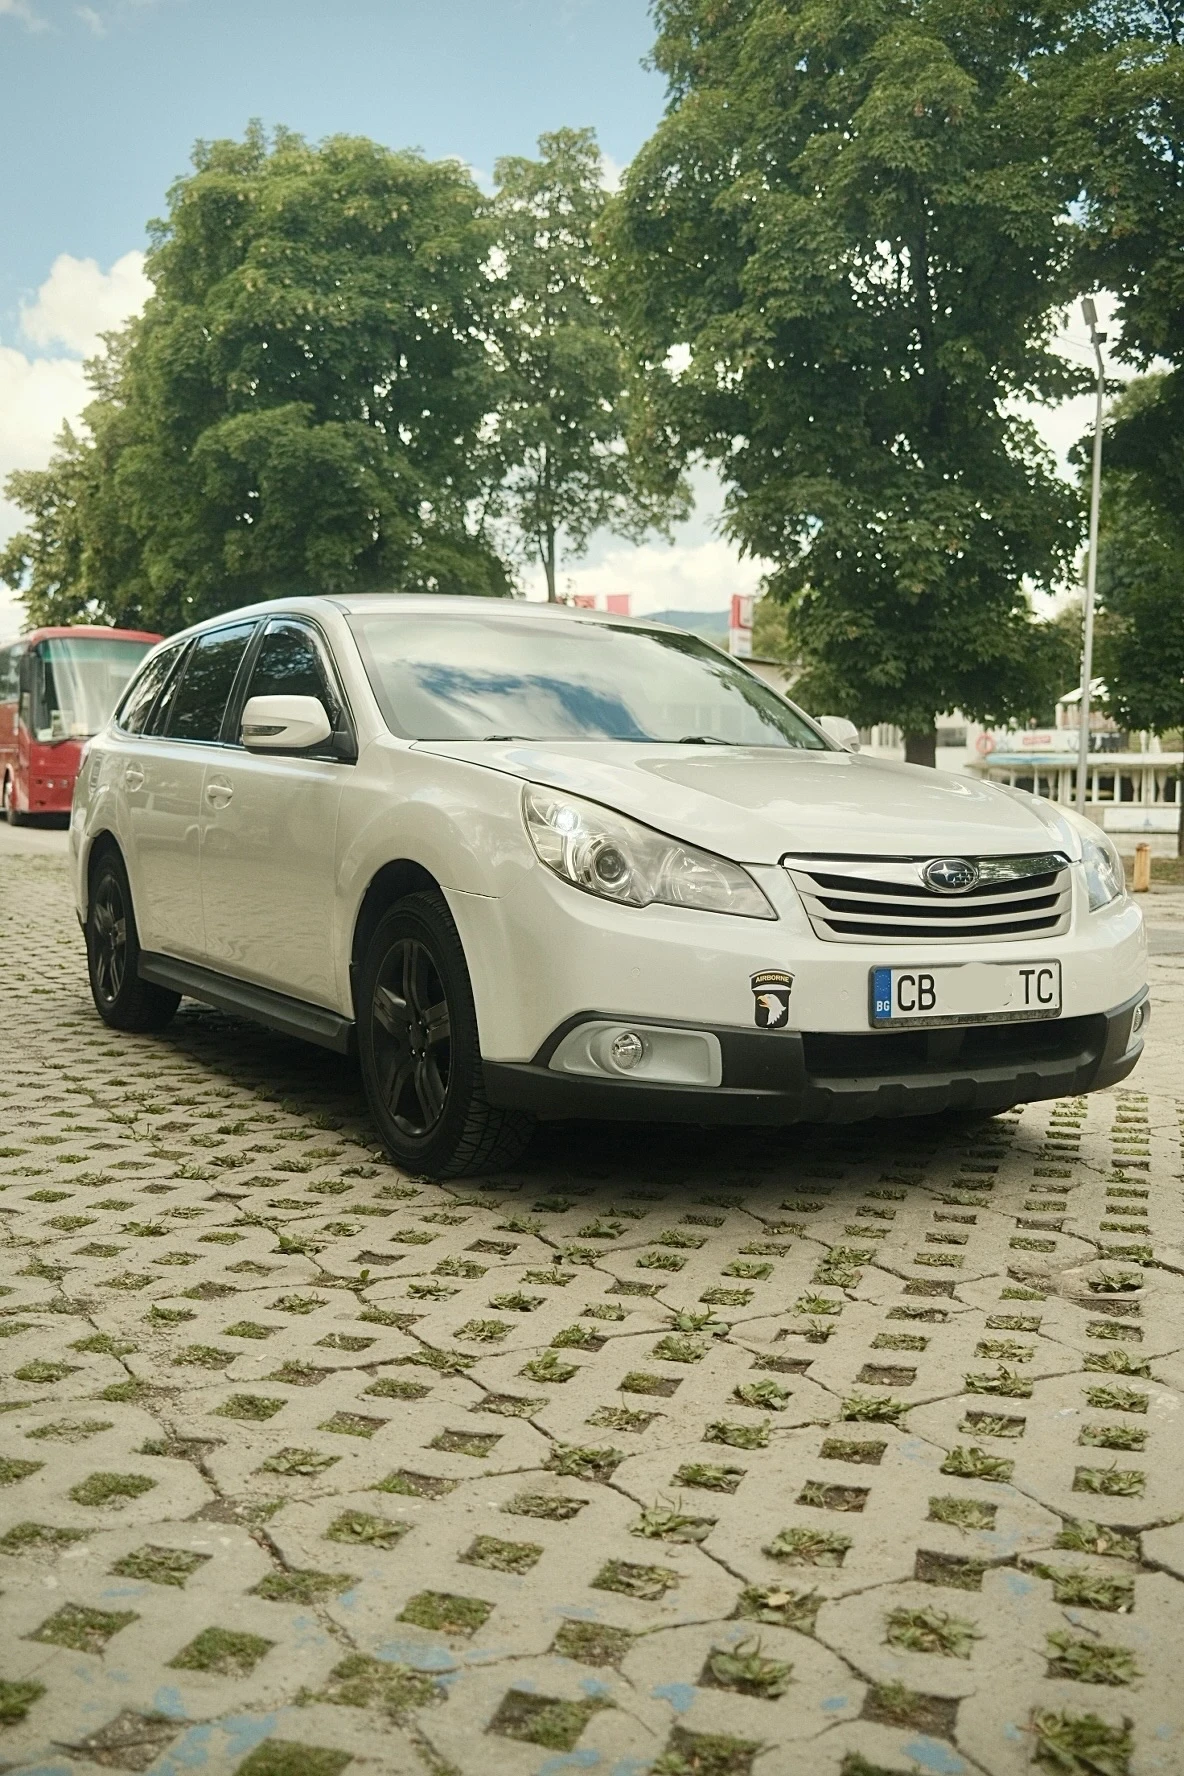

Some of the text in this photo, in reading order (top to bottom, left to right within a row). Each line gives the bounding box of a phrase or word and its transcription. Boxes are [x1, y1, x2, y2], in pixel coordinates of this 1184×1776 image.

[755, 974, 790, 983] AIRBORNE
[897, 968, 1053, 1011] CB TC
[876, 1000, 890, 1012] BG
